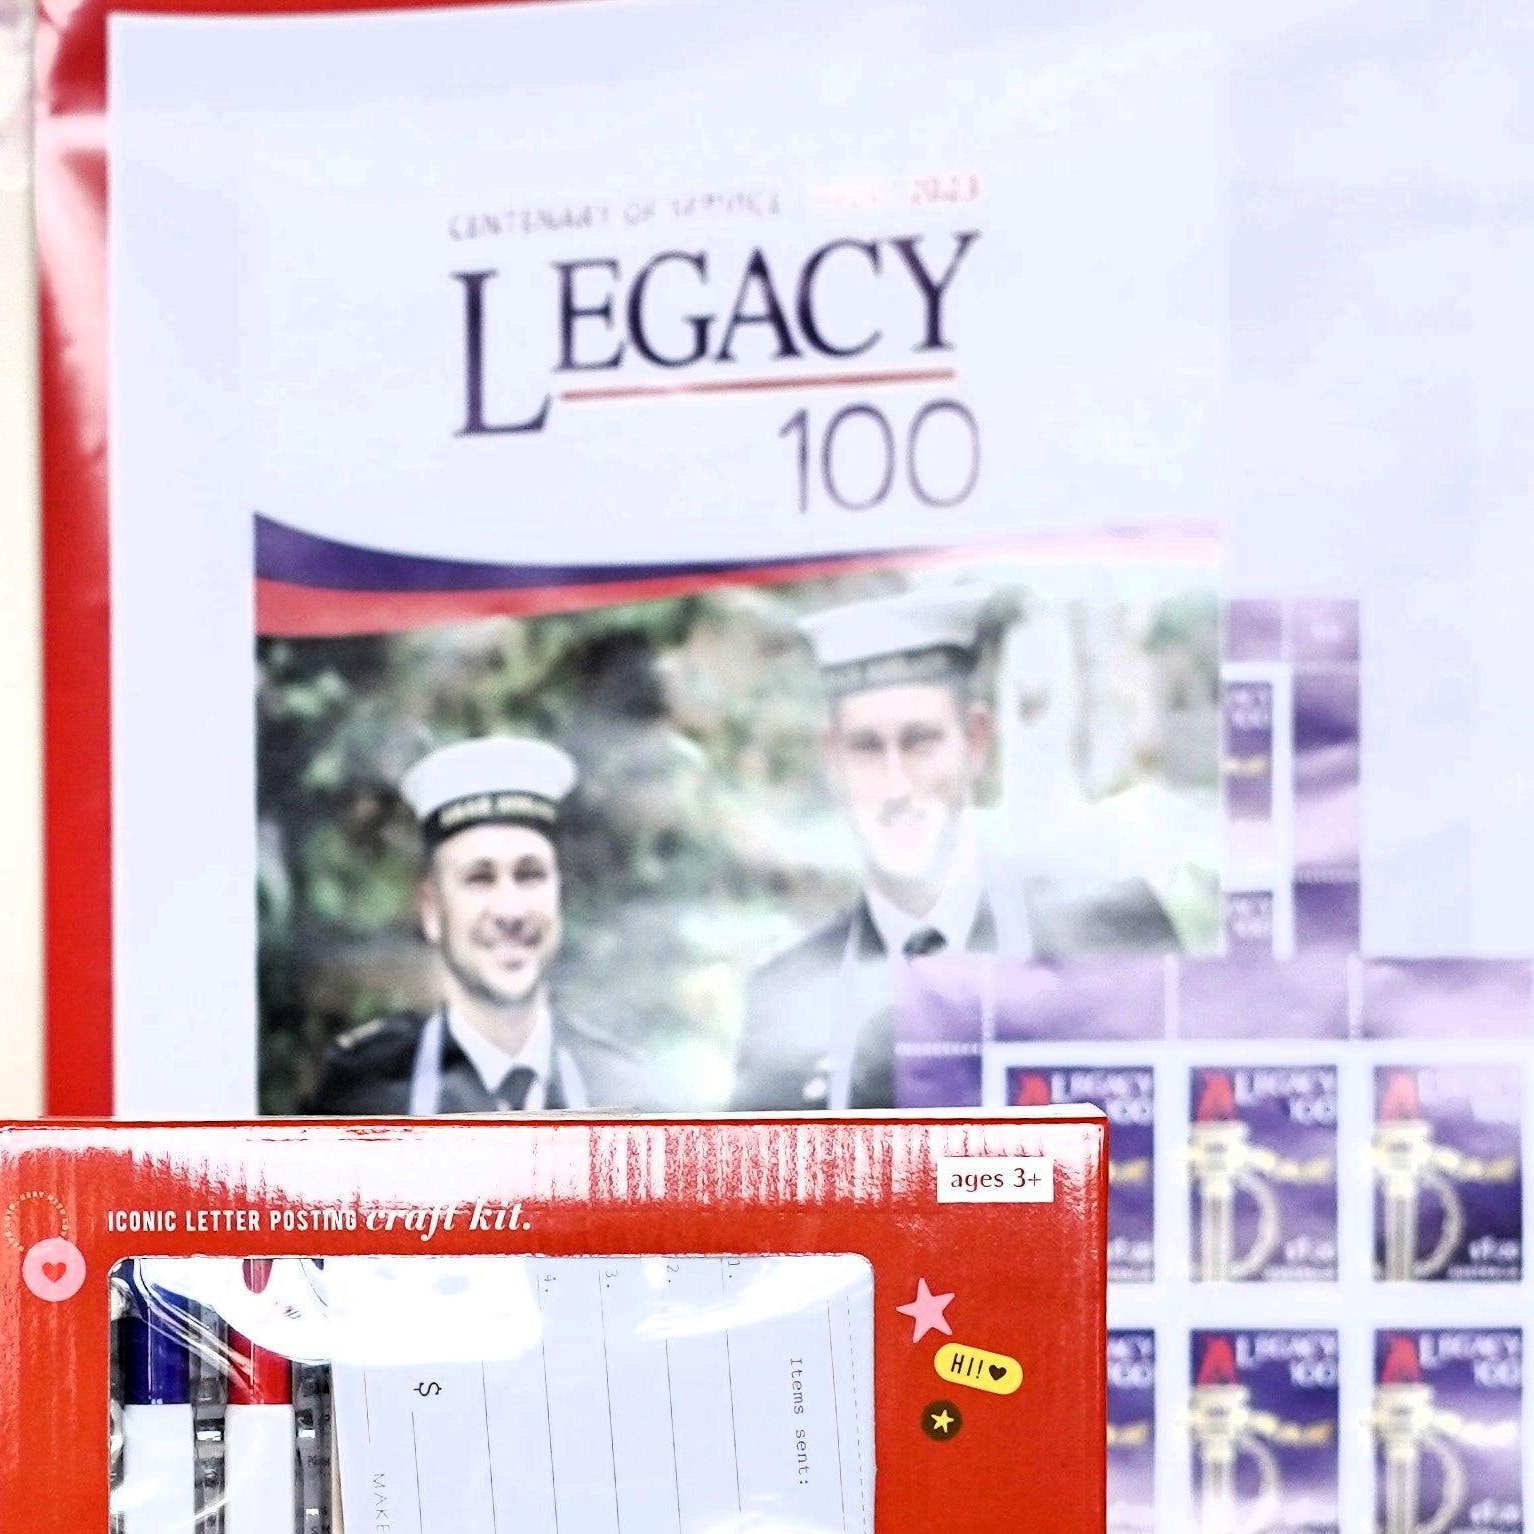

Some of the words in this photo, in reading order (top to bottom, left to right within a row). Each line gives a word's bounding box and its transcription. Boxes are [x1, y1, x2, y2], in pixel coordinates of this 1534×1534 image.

[452, 230, 982, 437] LEGACY
[778, 399, 983, 514] 100
[950, 1170, 1004, 1191] ages
[1013, 1168, 1043, 1189] 3+
[108, 1210, 177, 1232] ICONIC
[185, 1210, 260, 1231] LETTER
[270, 1208, 357, 1231] POSTING
[365, 1199, 456, 1241] craft
[469, 1199, 533, 1231] kit.
[413, 1381, 442, 1397] $
[789, 1356, 804, 1415] Items
[950, 1352, 984, 1380] HI!
[795, 1429, 810, 1486] sent:
[373, 1472, 391, 1534] MAKE
